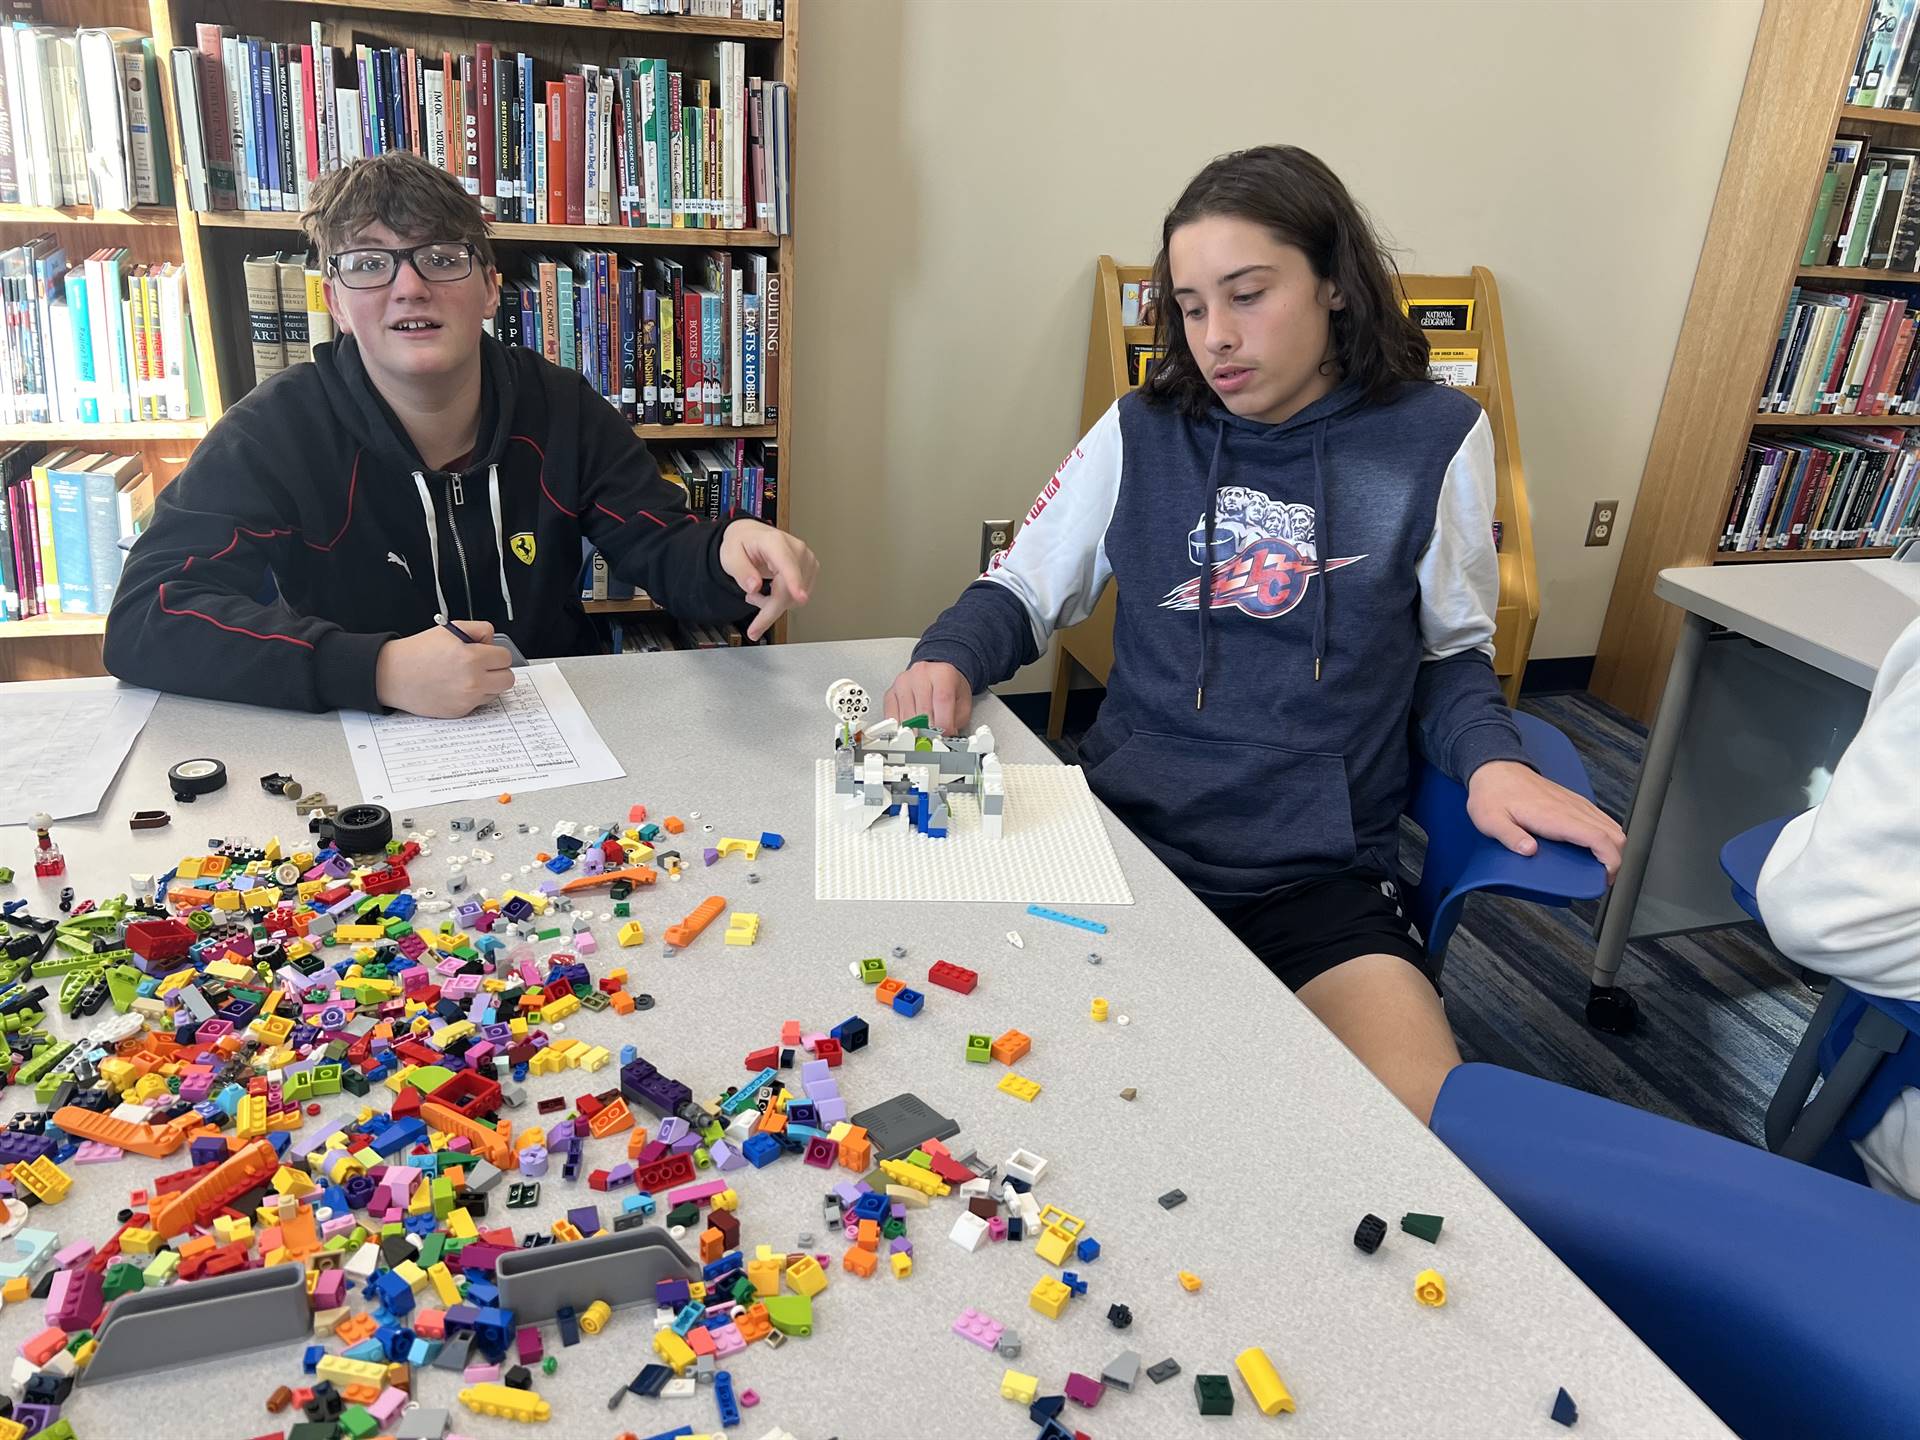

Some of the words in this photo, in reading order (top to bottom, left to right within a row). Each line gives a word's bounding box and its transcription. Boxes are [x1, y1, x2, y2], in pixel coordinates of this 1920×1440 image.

[588, 95, 596, 110] The
[588, 110, 596, 132] Roger
[467, 115, 477, 165] BOMB
[588, 133, 596, 154] Caras
[587, 156, 596, 170] Dog
[588, 170, 596, 189] Book
[546, 280, 554, 308] GREASE
[560, 282, 573, 326] FETCH
[746, 308, 756, 351] CRAFTS
[767, 278, 780, 351] QUILTING
[1420, 318, 1456, 326] GEOGRAPHIC
[252, 330, 280, 340] ART
[689, 320, 698, 358] BOXERS
[624, 332, 634, 373] DUNE
[644, 348, 656, 386] SUNSHIN
[746, 354, 756, 363] &
[746, 365, 756, 412] HOBBIES
[710, 484, 718, 520] STEPHEN
